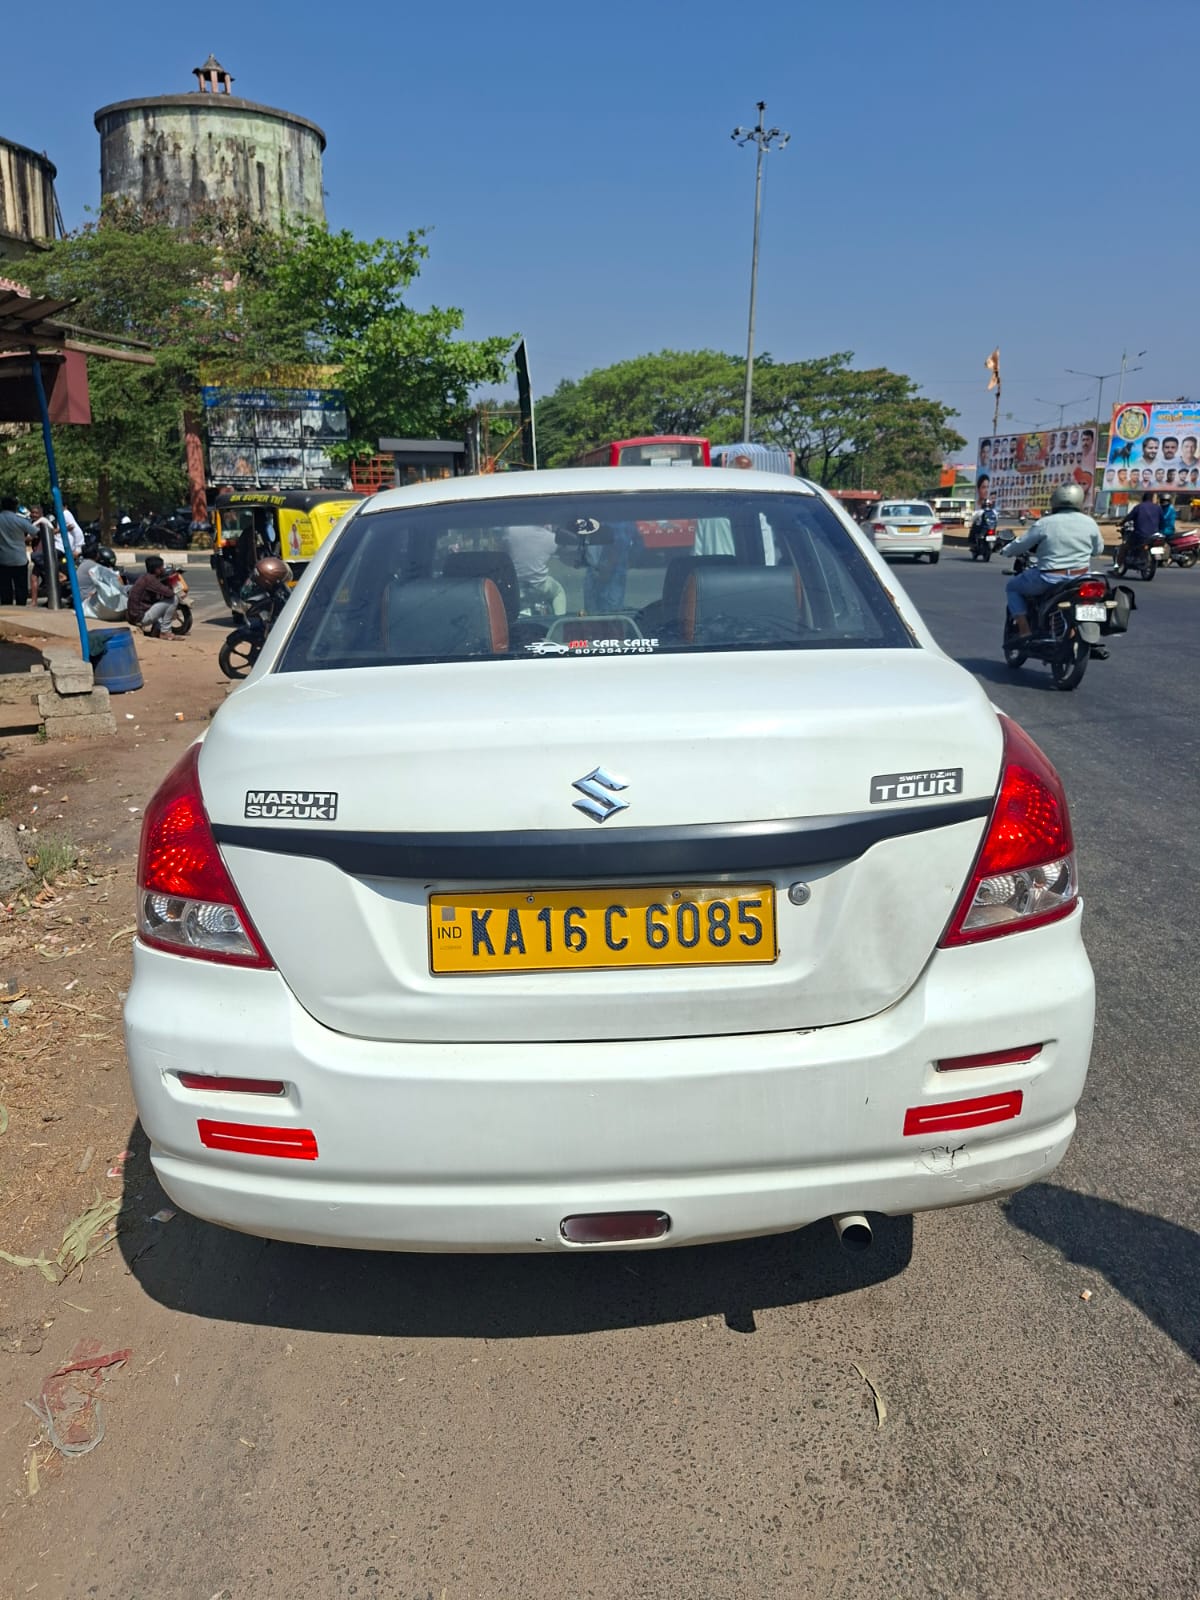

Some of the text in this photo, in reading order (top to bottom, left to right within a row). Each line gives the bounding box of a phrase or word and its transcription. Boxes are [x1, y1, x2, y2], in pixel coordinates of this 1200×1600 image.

[242, 494, 269, 503] SUPER
[593, 639, 619, 648] CAR
[624, 638, 660, 647] CARE
[899, 773, 929, 782] SWIFT
[875, 778, 957, 800] TOUR
[247, 792, 336, 806] MARUTI
[246, 805, 335, 819] SUZUKI
[645, 899, 763, 950] 6085
[437, 926, 463, 940] IND
